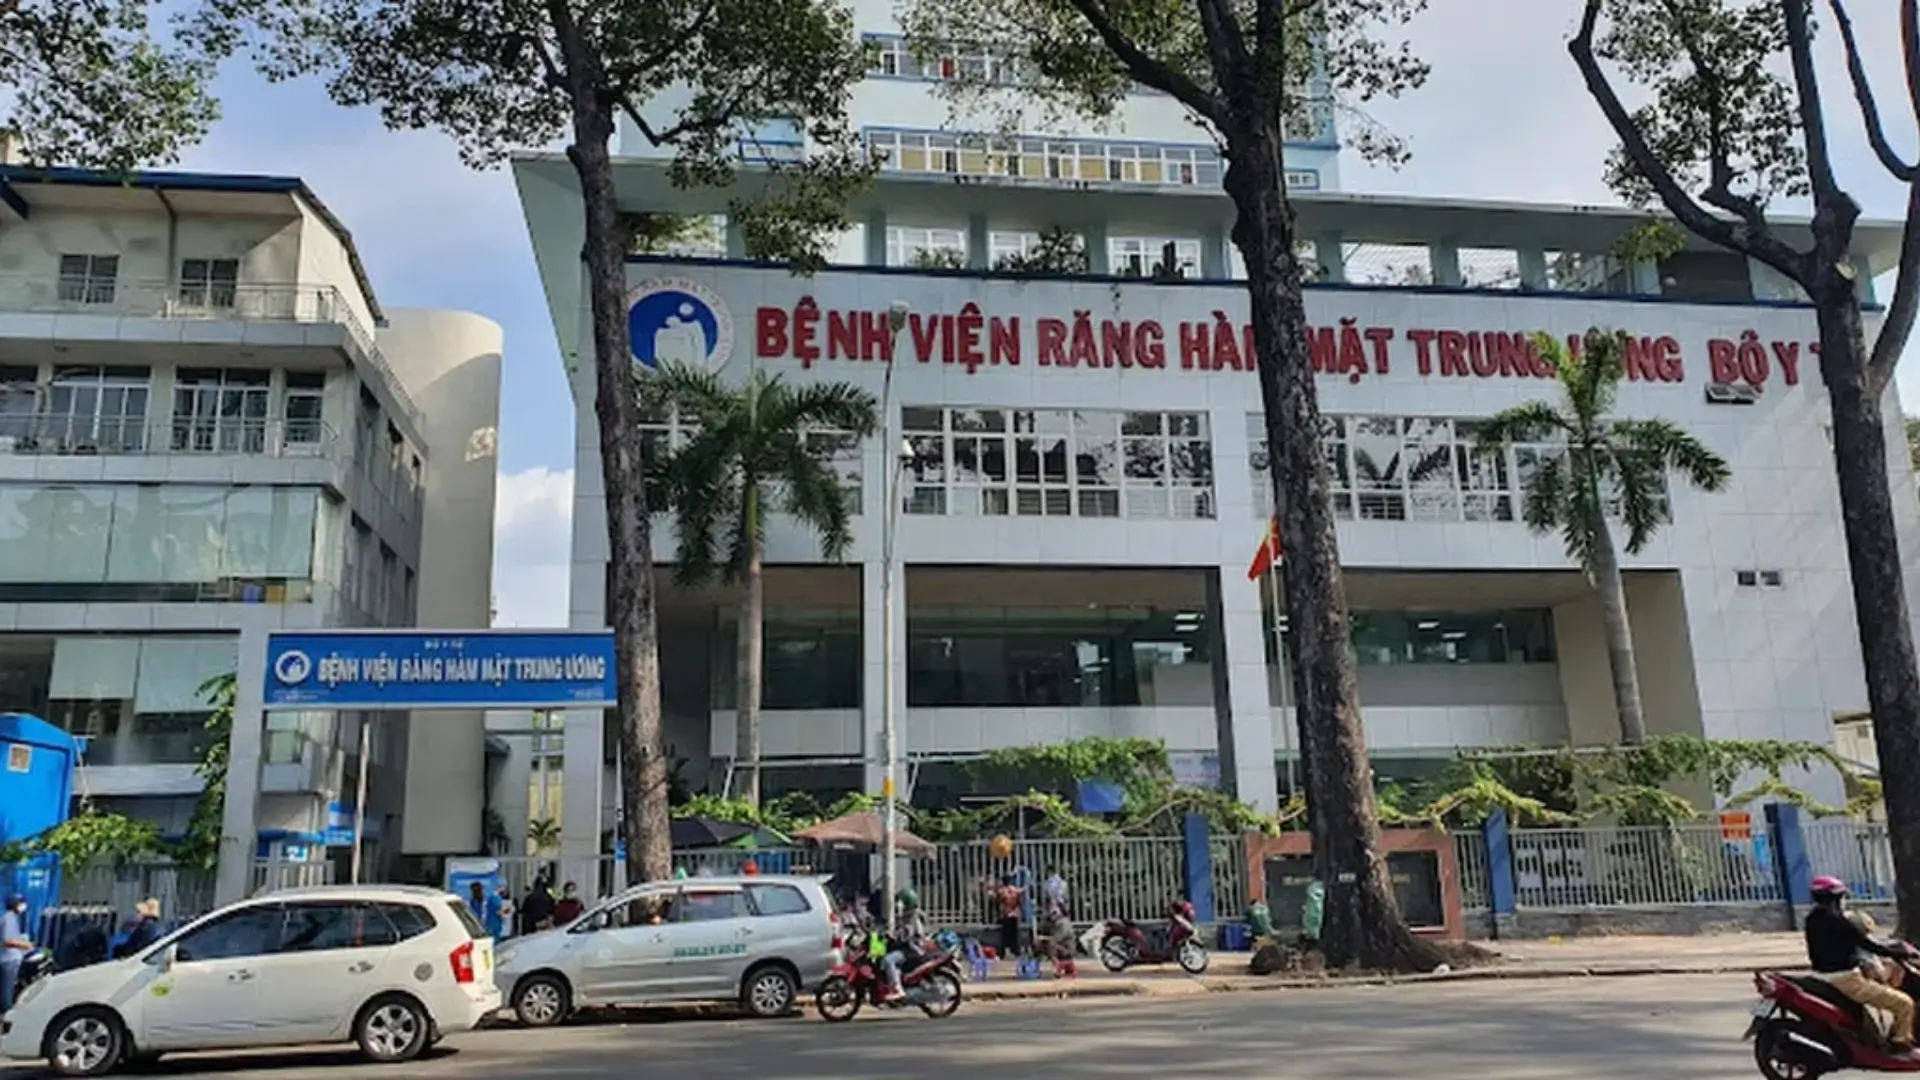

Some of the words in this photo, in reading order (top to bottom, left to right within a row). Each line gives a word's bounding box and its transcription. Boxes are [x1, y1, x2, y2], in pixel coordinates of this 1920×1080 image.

[757, 295, 890, 369] BỆNH
[908, 302, 1021, 374] VIỆN
[1037, 309, 1167, 369] RĂNG
[1305, 317, 1394, 384] MẶT
[1707, 330, 1770, 393] BỘ
[1771, 341, 1799, 386] Y
[317, 652, 359, 688] BỆNH
[362, 652, 398, 688] VIỆN
[445, 652, 479, 681] HÀM
[515, 656, 563, 680] TRUNG
